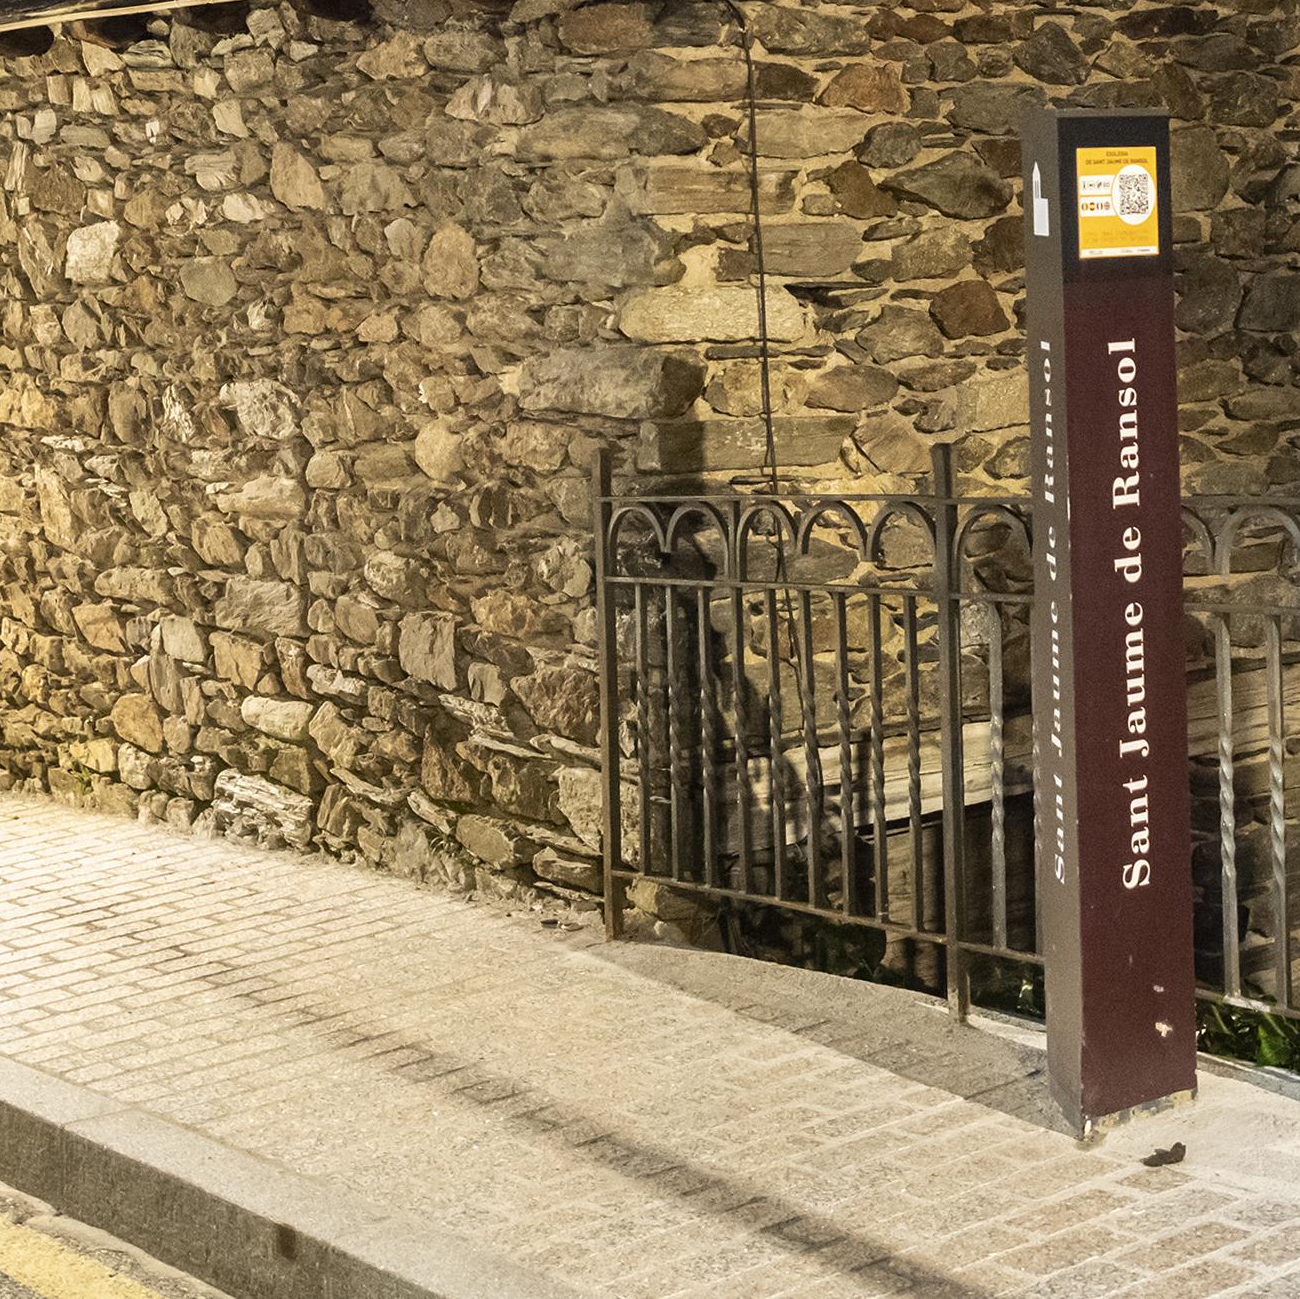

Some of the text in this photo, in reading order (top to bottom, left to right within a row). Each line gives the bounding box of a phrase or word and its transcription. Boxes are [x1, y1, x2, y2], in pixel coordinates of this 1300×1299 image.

[1041, 340, 1065, 884] Sant Jaume de Ransol
[1108, 338, 1150, 890] Sant Jaume de Ransol
